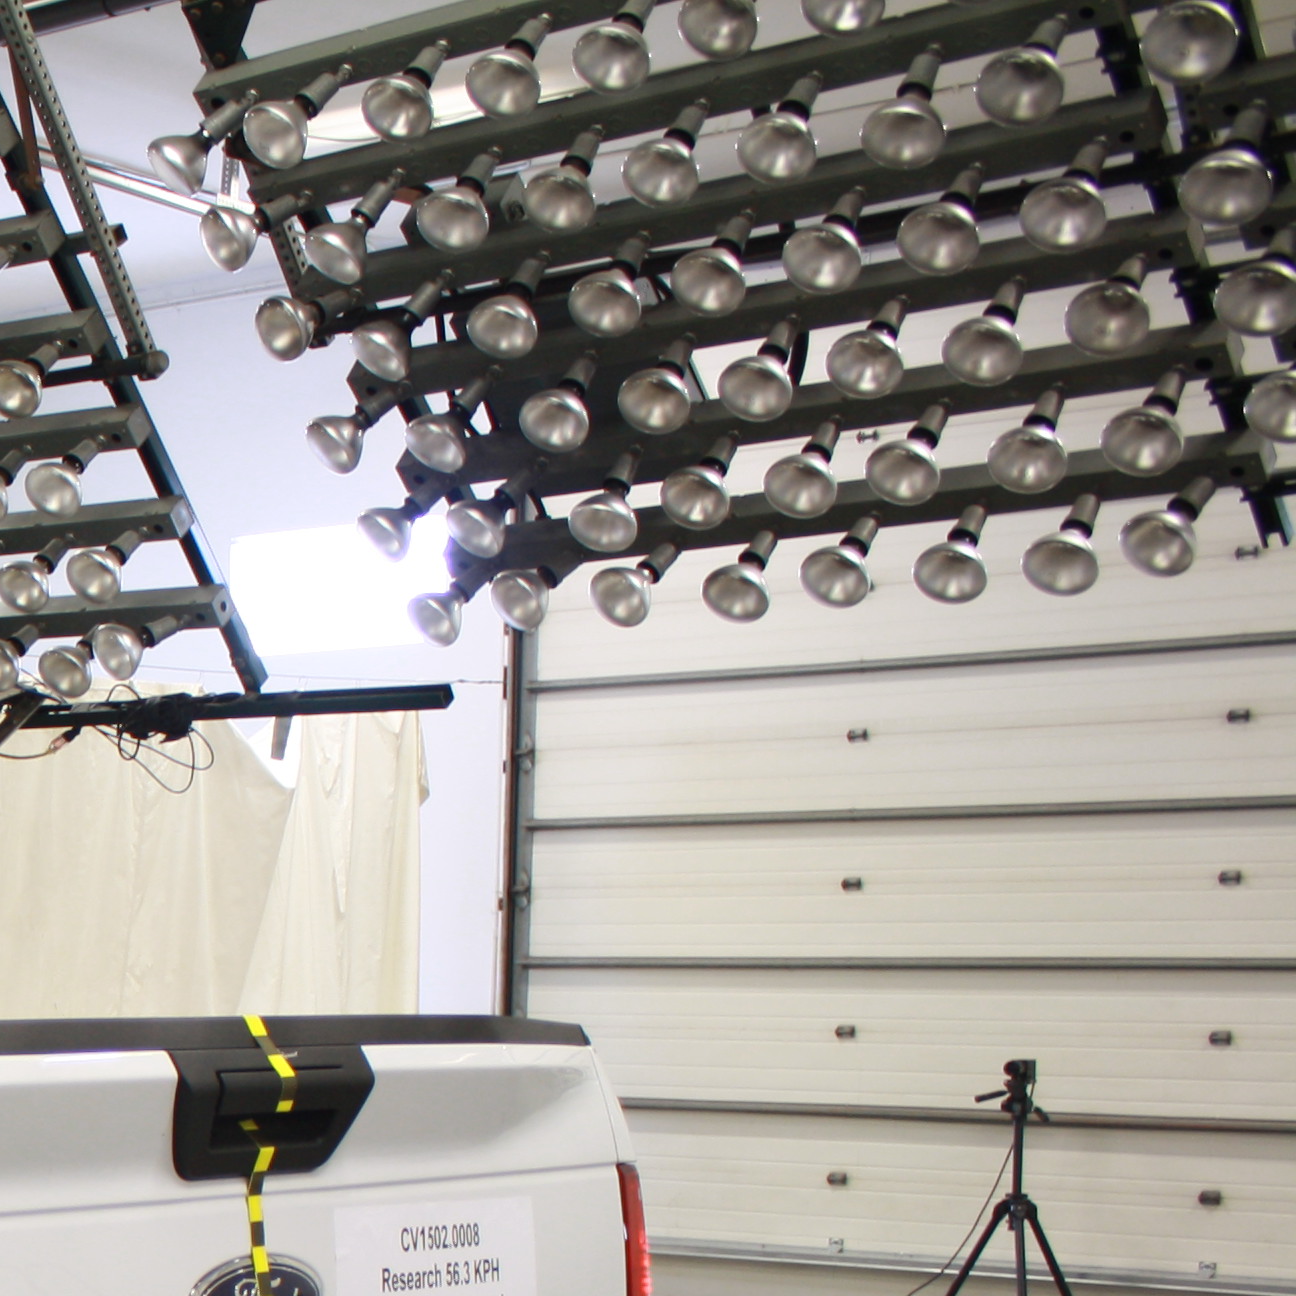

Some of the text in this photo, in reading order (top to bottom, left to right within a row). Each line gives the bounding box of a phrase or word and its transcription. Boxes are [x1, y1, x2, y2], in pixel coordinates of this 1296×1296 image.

[401, 1222, 480, 1252] CV1502.0008
[381, 1258, 500, 1293] Research 56.3 KPH
